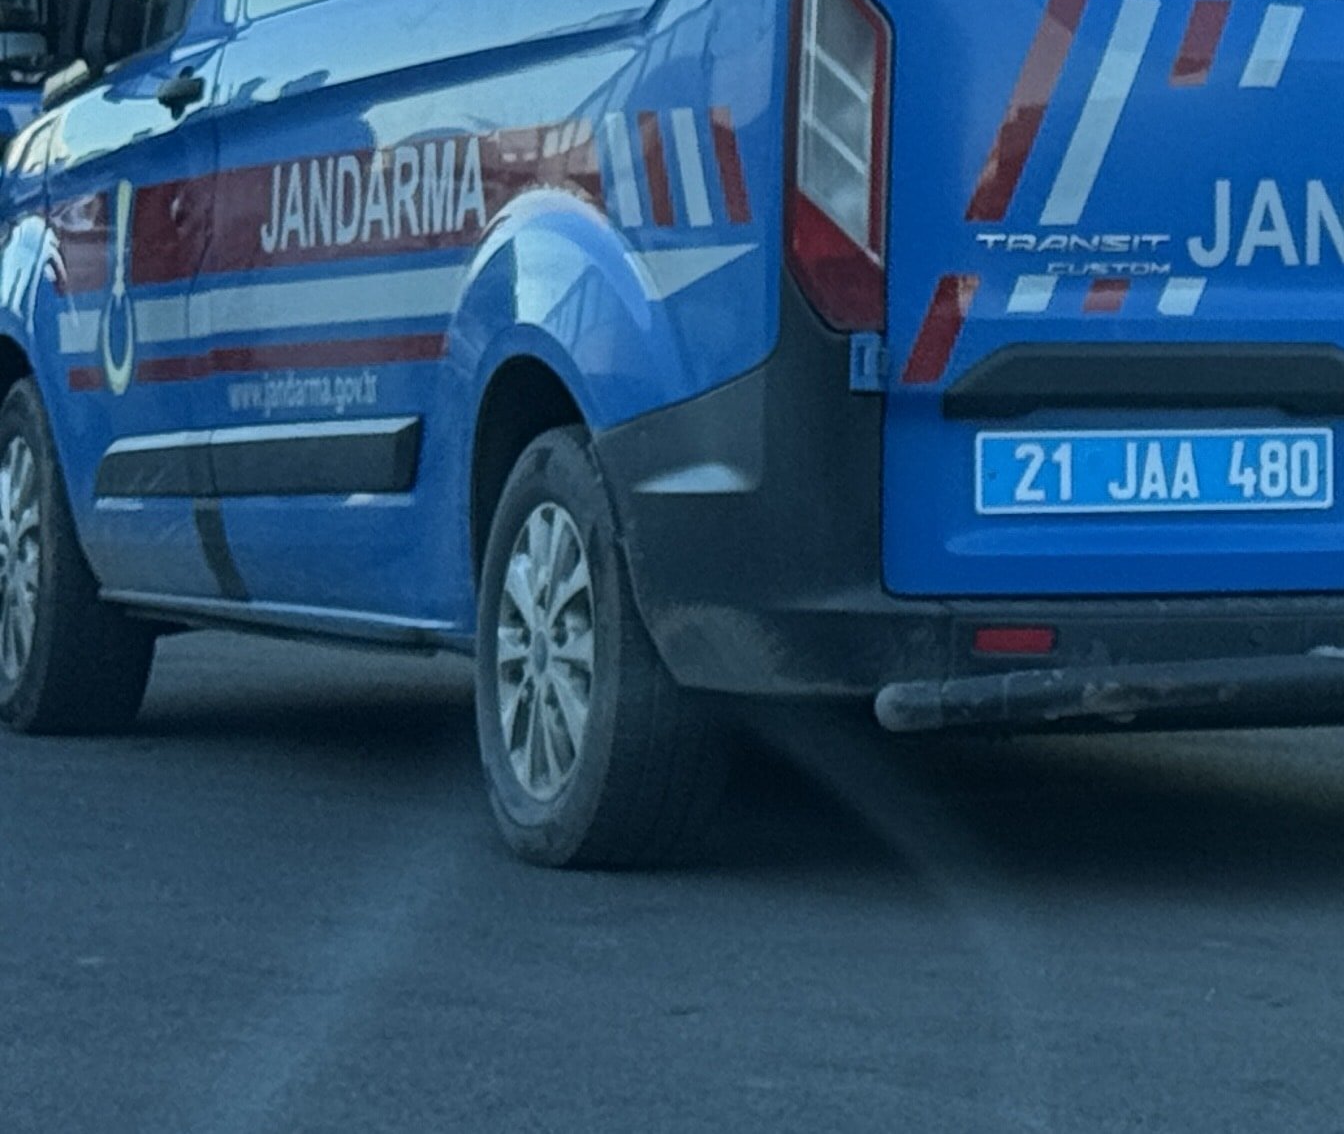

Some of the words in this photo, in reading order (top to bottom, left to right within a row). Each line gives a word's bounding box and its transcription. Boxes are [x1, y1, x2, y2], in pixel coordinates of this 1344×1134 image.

[261, 136, 487, 254] JANDARMA
[975, 233, 1170, 253] TRANSIT
[1047, 262, 1172, 276] CUSTOM
[228, 369, 378, 414] www.jandarma.gov.tr
[1013, 443, 1074, 501] 21
[1107, 440, 1200, 500] JAA
[1228, 438, 1321, 498] 480
